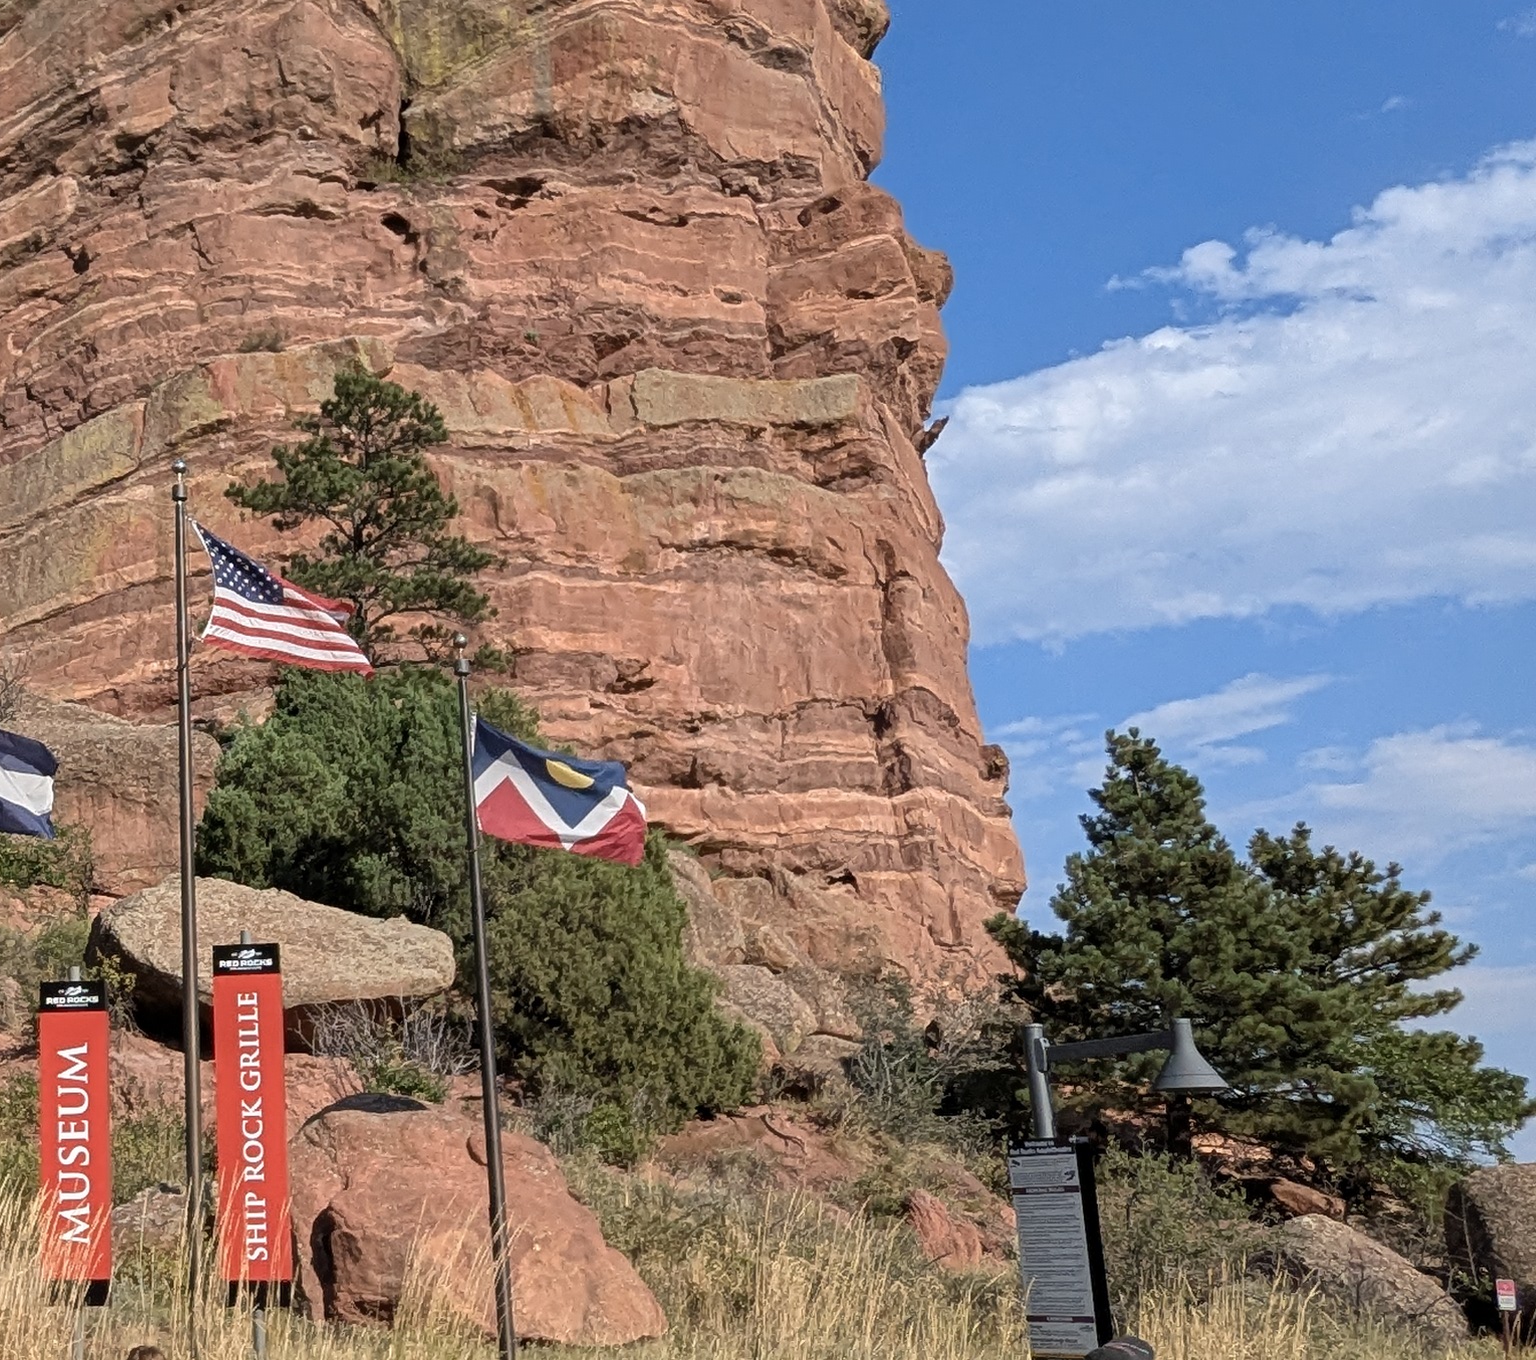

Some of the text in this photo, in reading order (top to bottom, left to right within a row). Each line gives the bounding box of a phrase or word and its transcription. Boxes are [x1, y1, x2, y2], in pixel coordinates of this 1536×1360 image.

[219, 960, 239, 968] RED
[237, 991, 260, 1092] GRILLE
[56, 1042, 90, 1246] MUSEUM
[240, 1095, 265, 1183] ROCK
[244, 1191, 268, 1261] SHIP
